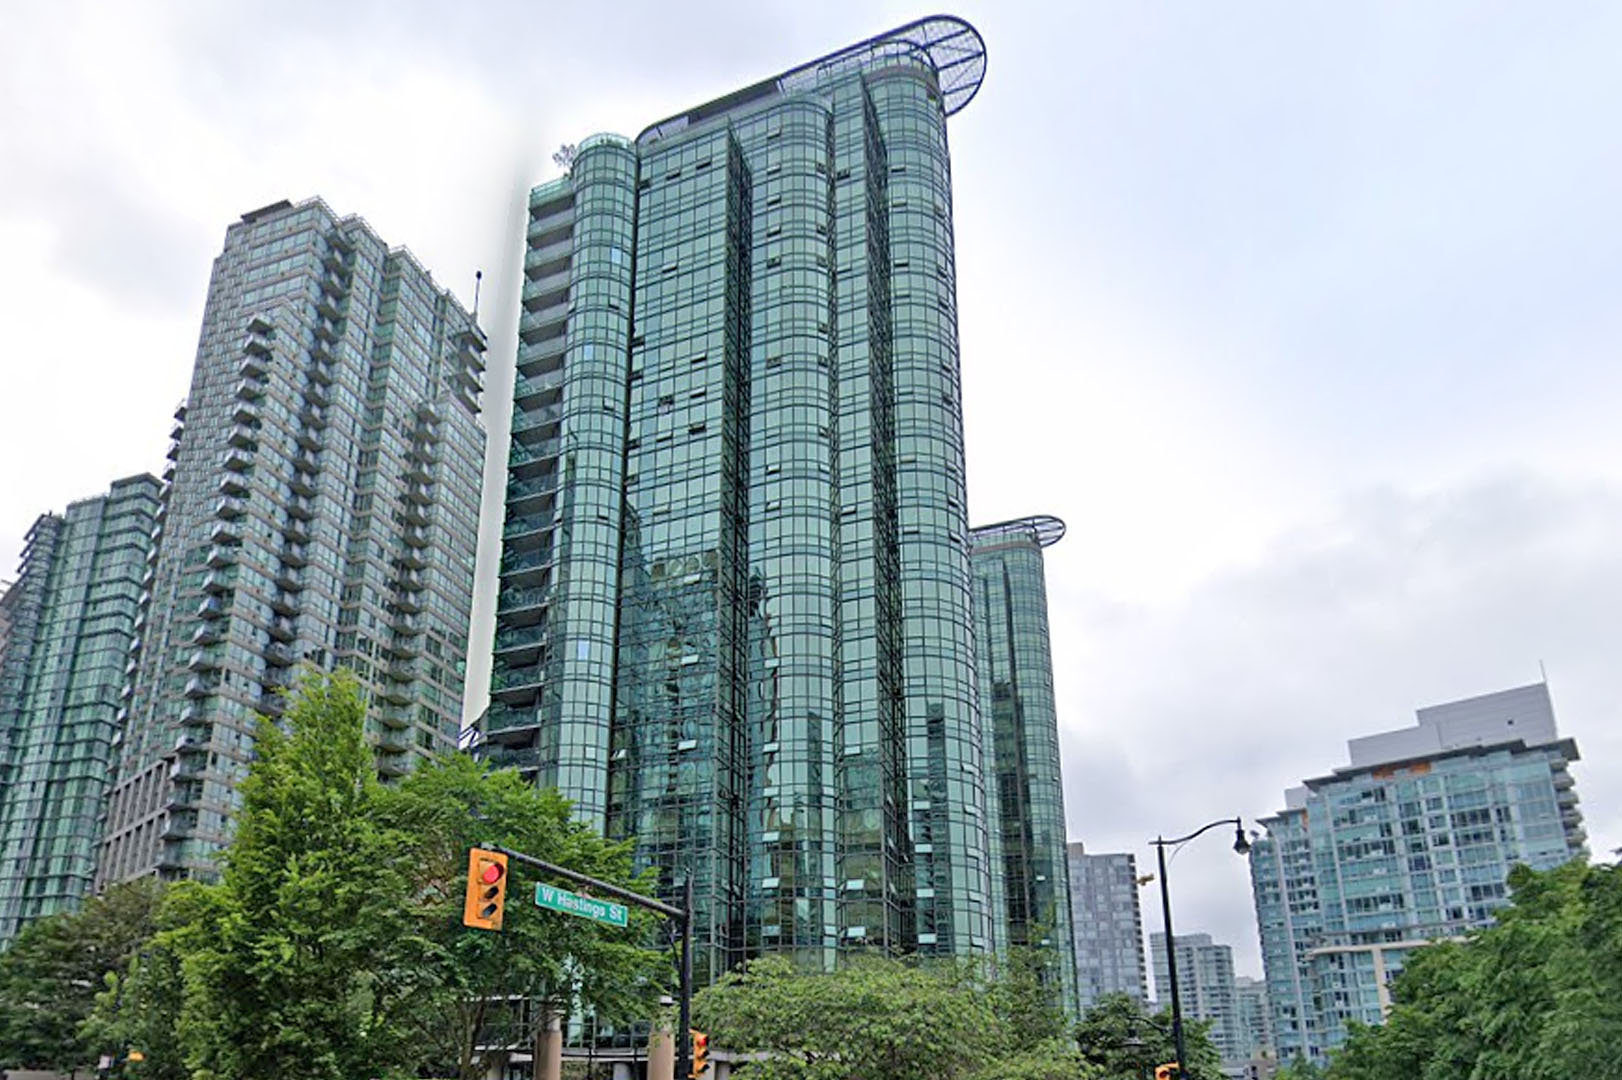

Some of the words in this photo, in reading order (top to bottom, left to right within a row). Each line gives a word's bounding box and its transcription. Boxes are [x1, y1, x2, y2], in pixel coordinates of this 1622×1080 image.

[542, 887, 554, 903] W
[557, 892, 606, 919] Hastings
[608, 903, 623, 921] St
